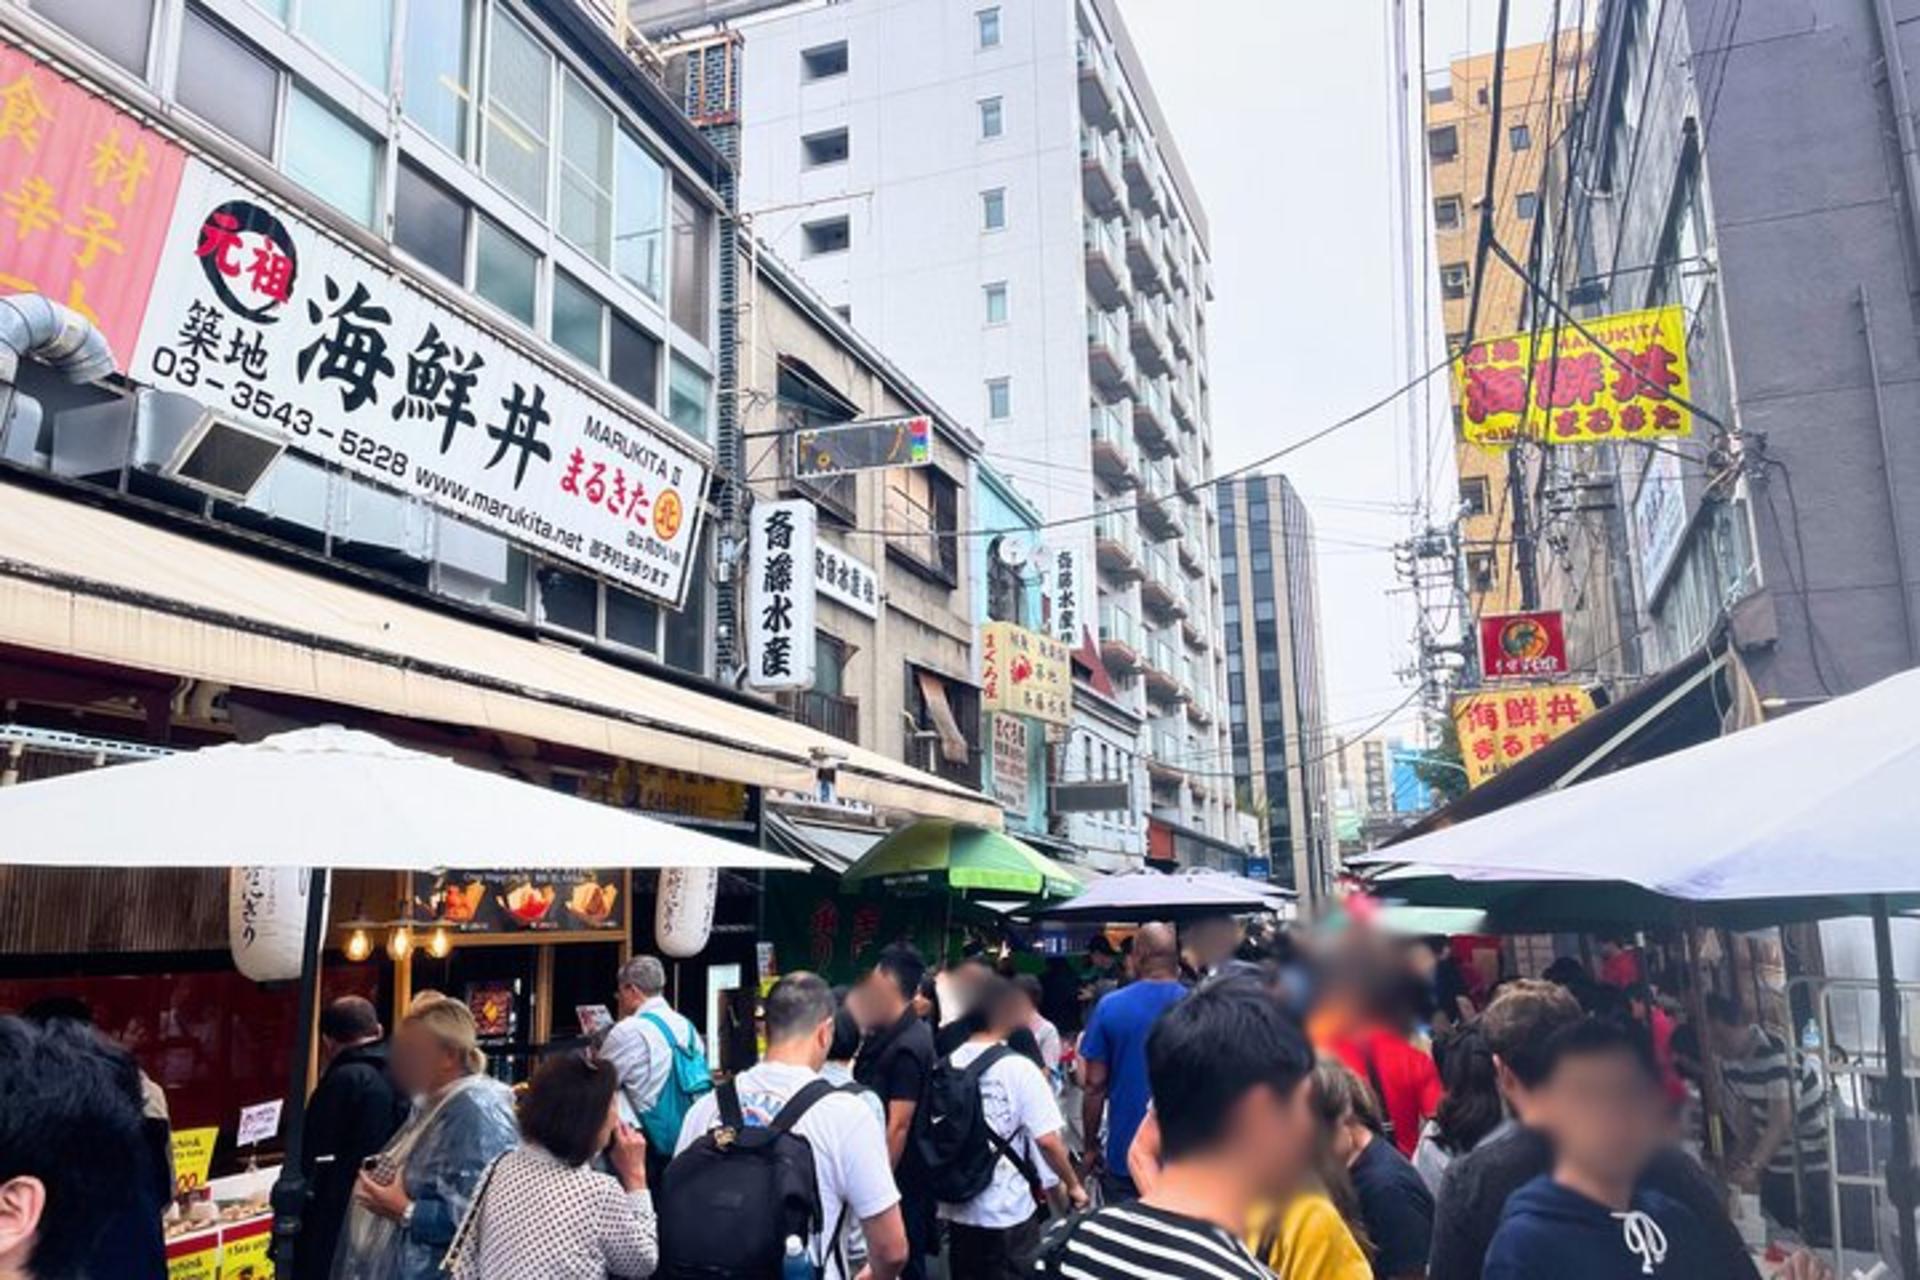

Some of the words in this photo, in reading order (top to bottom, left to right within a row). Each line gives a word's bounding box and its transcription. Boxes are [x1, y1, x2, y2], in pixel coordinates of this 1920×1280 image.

[195, 211, 293, 303] 元祖
[177, 299, 269, 382] 築地
[297, 273, 552, 491] 海鮮丼
[1555, 404, 1681, 438] まるきた
[560, 447, 650, 527] まるきた
[583, 415, 668, 481] MARUKITA
[415, 466, 584, 554] www.marukita.net
[1467, 693, 1582, 733] 海鮮丼
